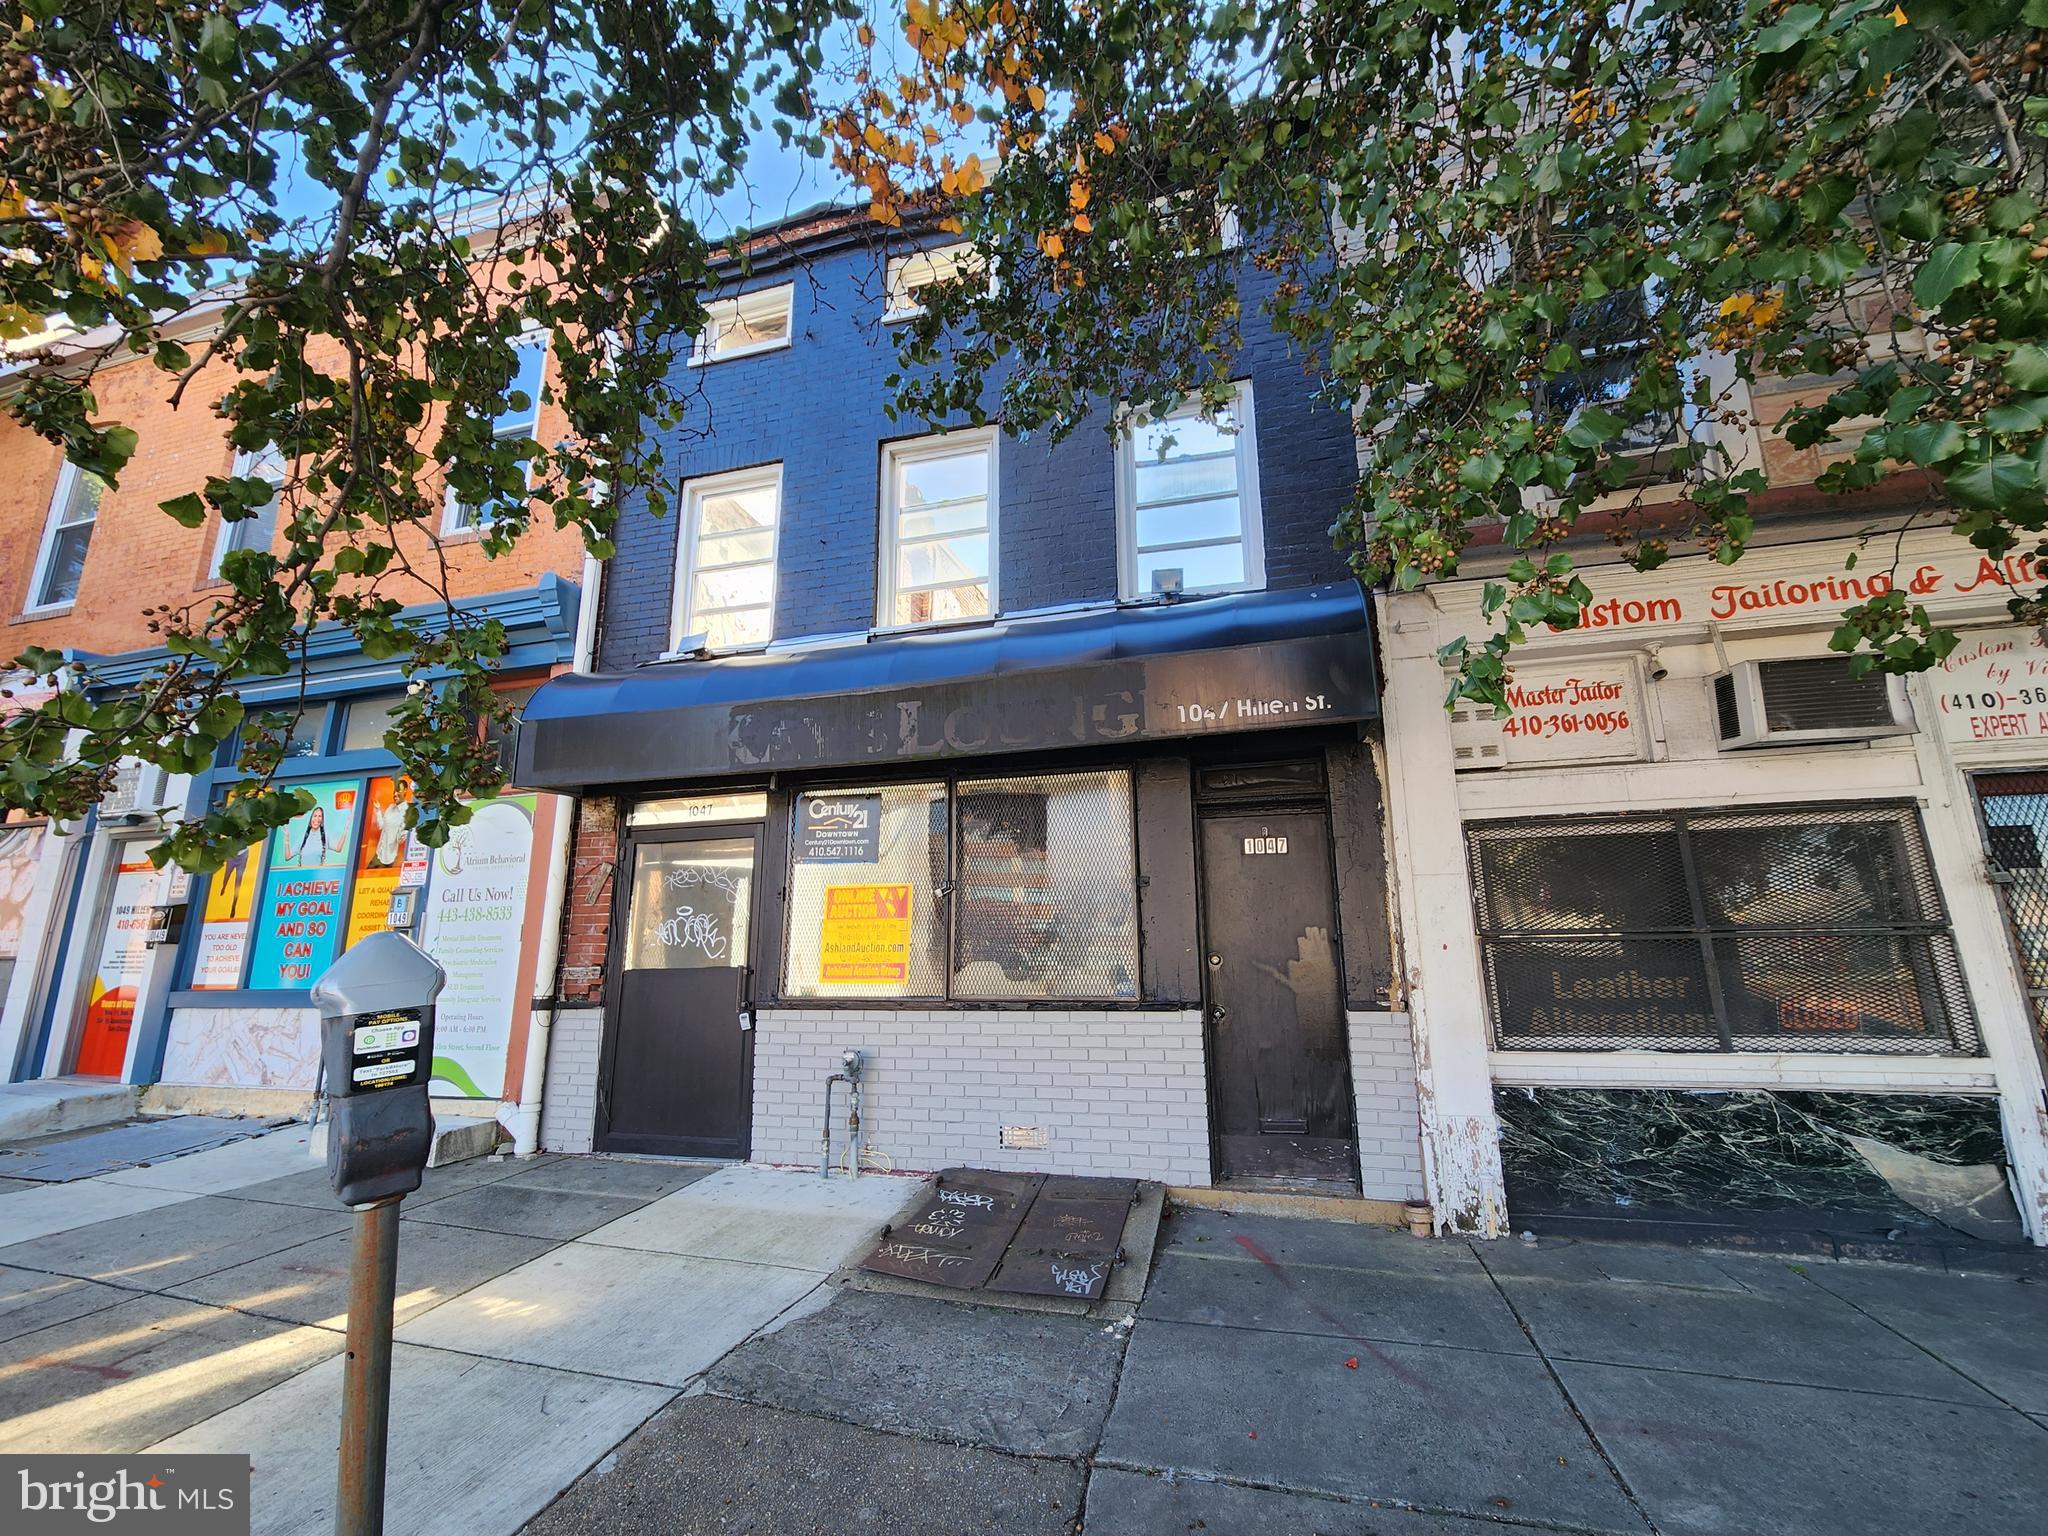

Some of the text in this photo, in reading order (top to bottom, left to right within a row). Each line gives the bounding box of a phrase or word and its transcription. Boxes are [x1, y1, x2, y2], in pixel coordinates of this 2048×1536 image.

[1547, 597, 1682, 632] ustom
[1909, 565, 1945, 594] &
[1987, 662, 2011, 685] by
[1506, 678, 1623, 708] Master Tailor
[1502, 710, 1630, 739] 410-361-0056
[1970, 713, 2028, 738] EXPERT
[689, 804, 713, 817] 1047
[808, 799, 868, 829] Century 21
[808, 846, 864, 857] 410.547.1116
[1245, 838, 1286, 853] 1047
[466, 852, 526, 866] Atrium Behavioral
[277, 880, 340, 897] I ACHIEVE
[442, 886, 514, 903] Call Us Now!
[276, 900, 334, 917] MY GOAL
[437, 906, 513, 923] 443-438-8533
[390, 913, 407, 924] 1049
[276, 921, 326, 937] AND SO
[284, 942, 313, 958] CAN
[824, 942, 904, 953] AshlandAuction.com
[1551, 969, 1690, 1000] Leather
[381, 1016, 408, 1024] OPTIONS
